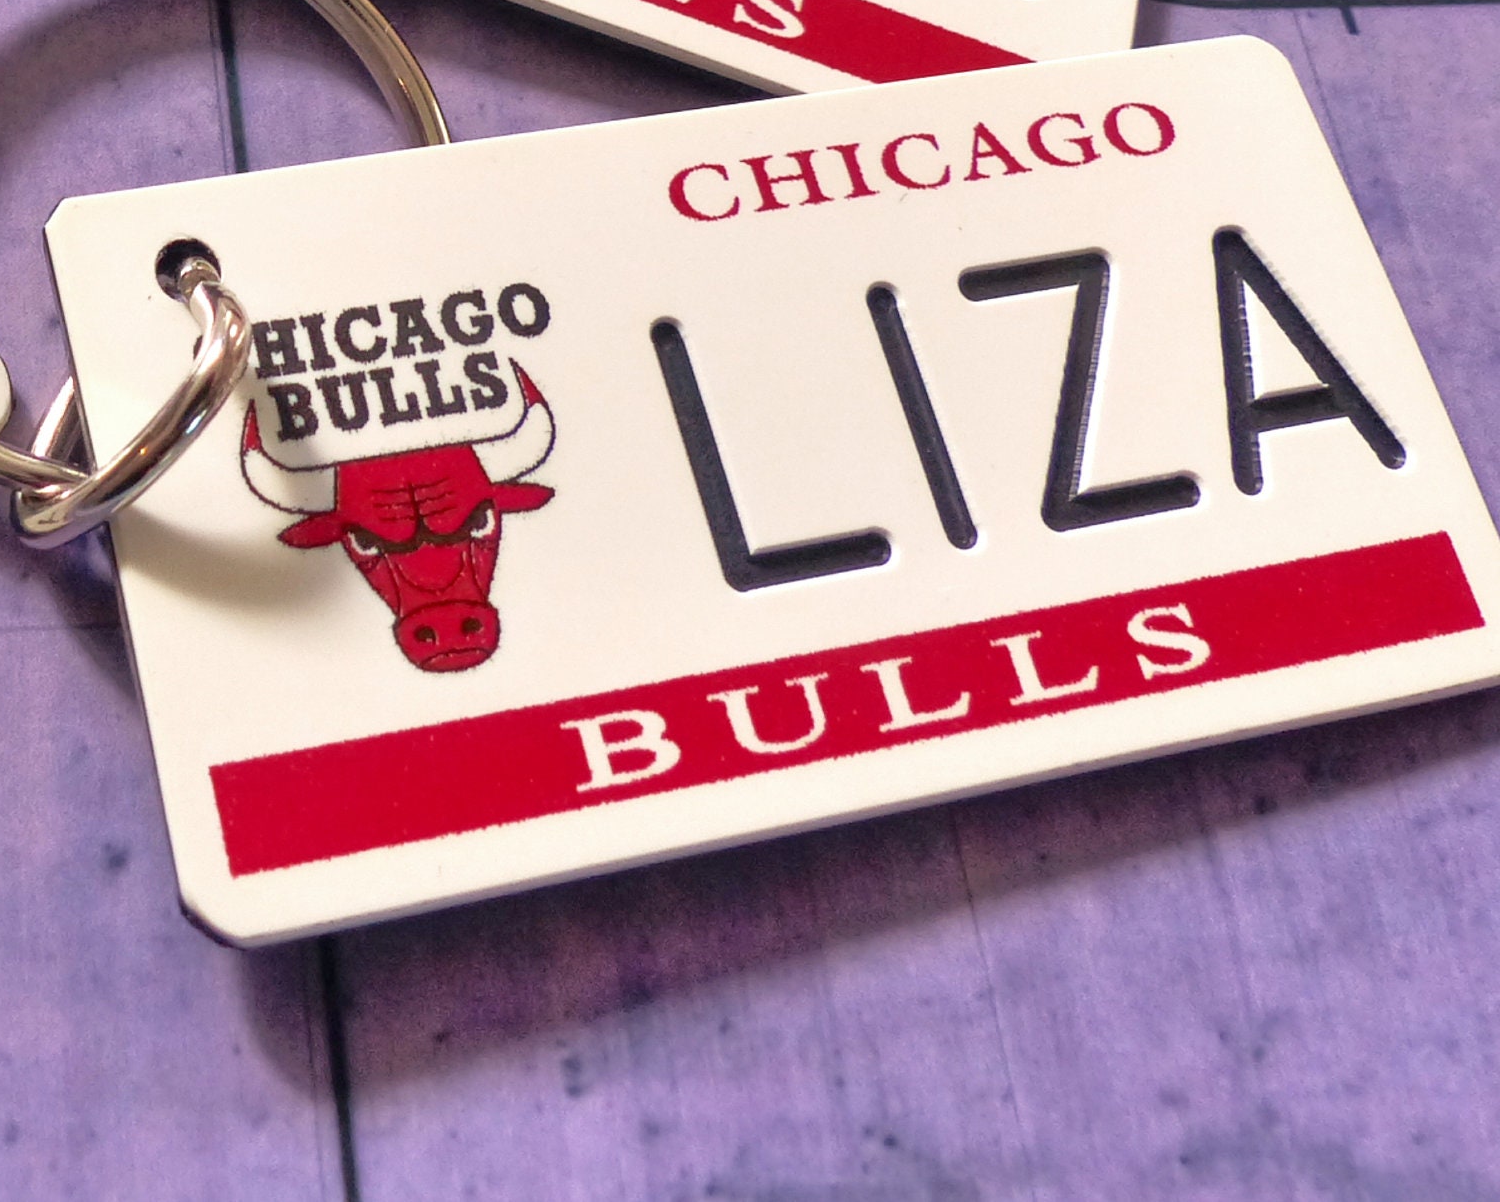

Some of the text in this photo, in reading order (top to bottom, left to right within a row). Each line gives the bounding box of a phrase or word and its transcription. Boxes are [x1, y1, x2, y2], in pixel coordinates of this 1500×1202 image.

[669, 101, 1175, 222] CHICAGO
[194, 283, 551, 380] HICAGO
[268, 351, 508, 441] BULLS
[649, 224, 1406, 592] LIZA
[562, 603, 1213, 794] BULLS
